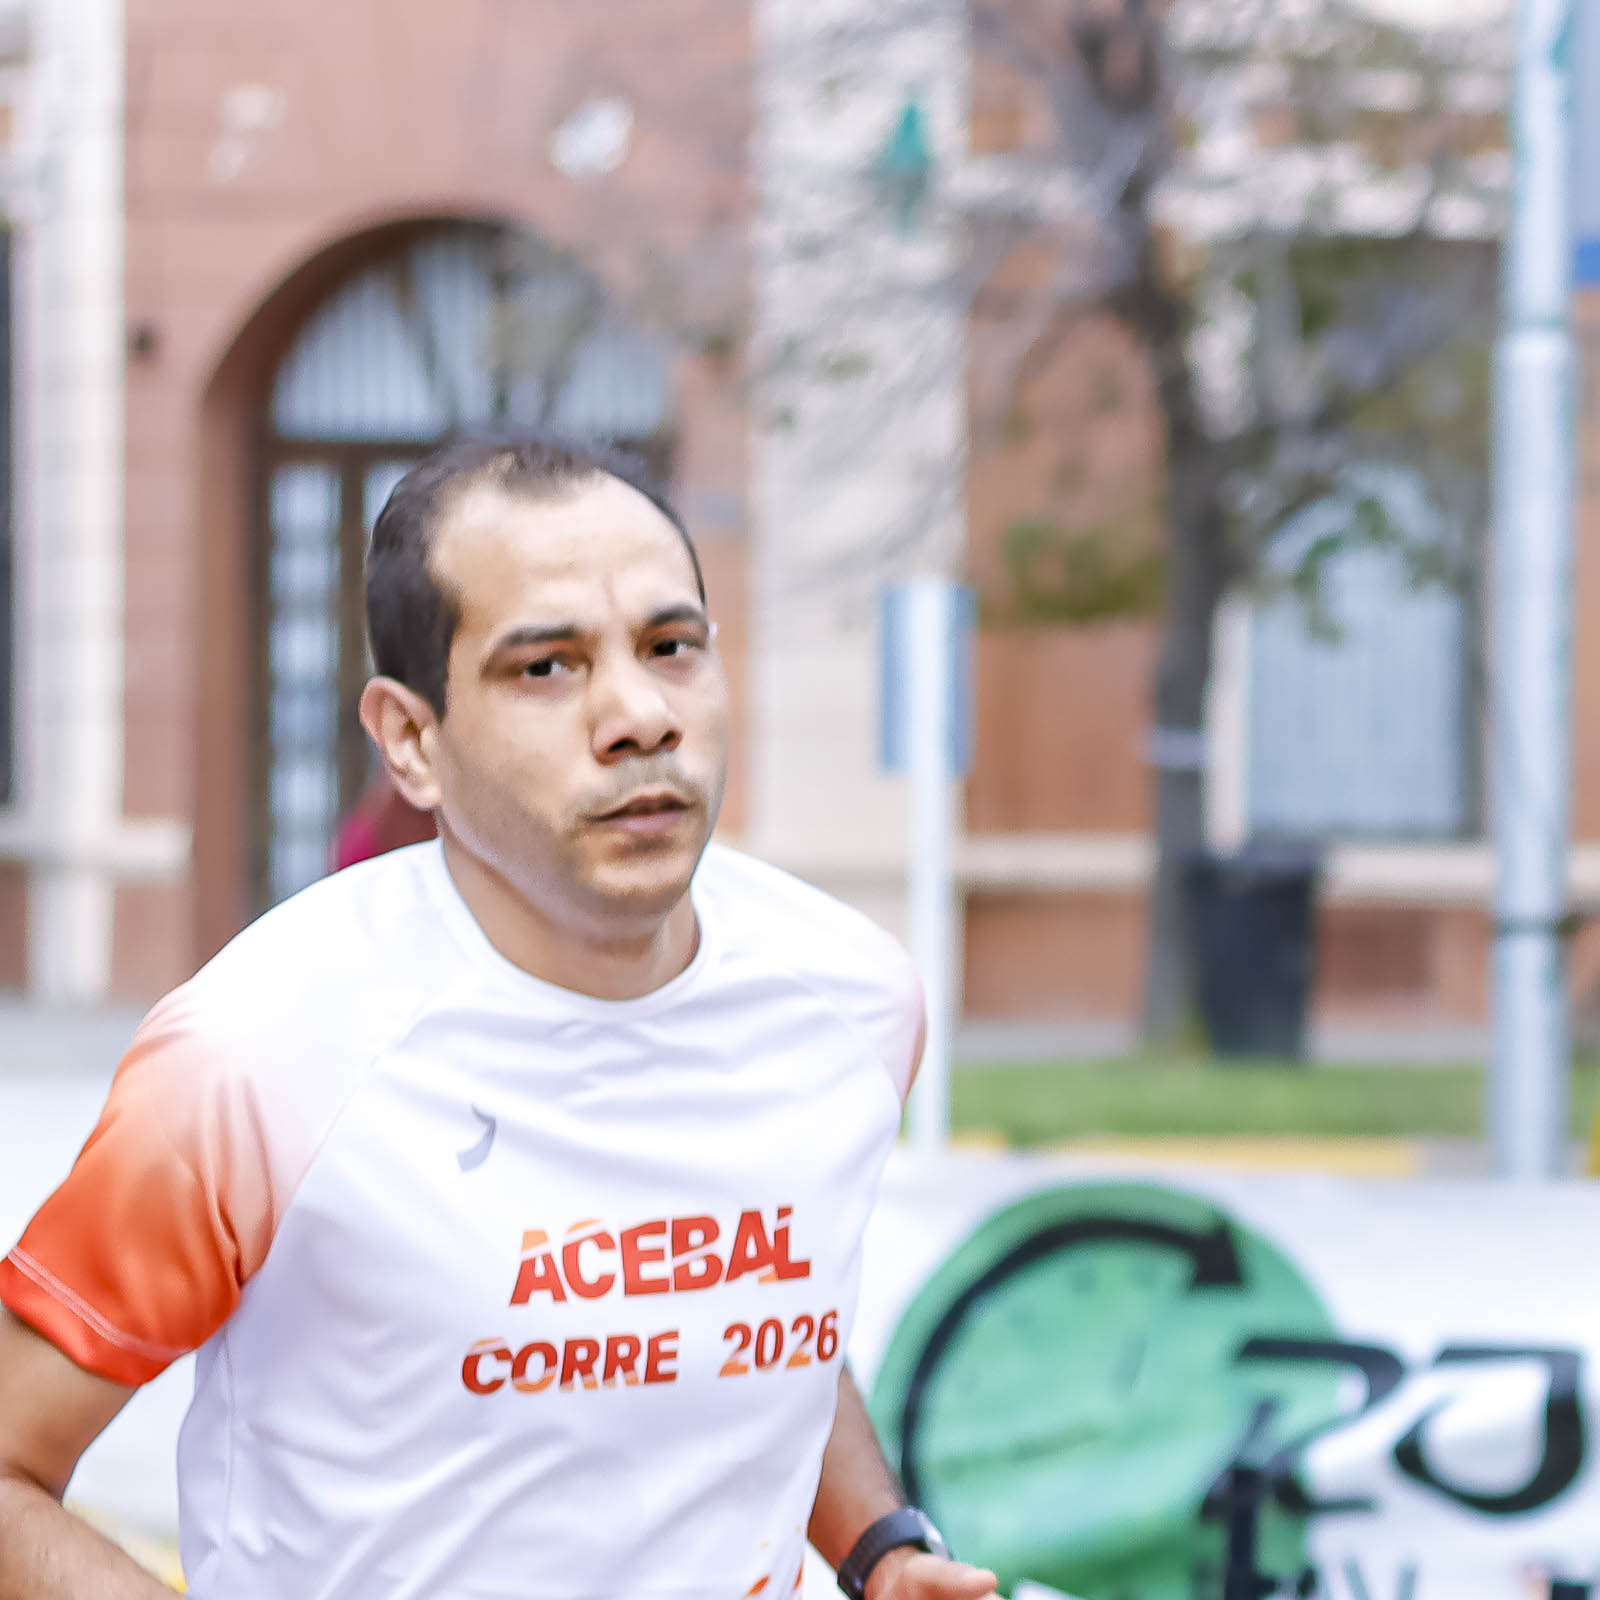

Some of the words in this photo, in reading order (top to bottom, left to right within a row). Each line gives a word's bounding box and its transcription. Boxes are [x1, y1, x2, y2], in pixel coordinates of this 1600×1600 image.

[509, 1204, 811, 1306] ACEBAL
[461, 1329, 680, 1396] CORRE
[717, 1309, 839, 1379] 2026
